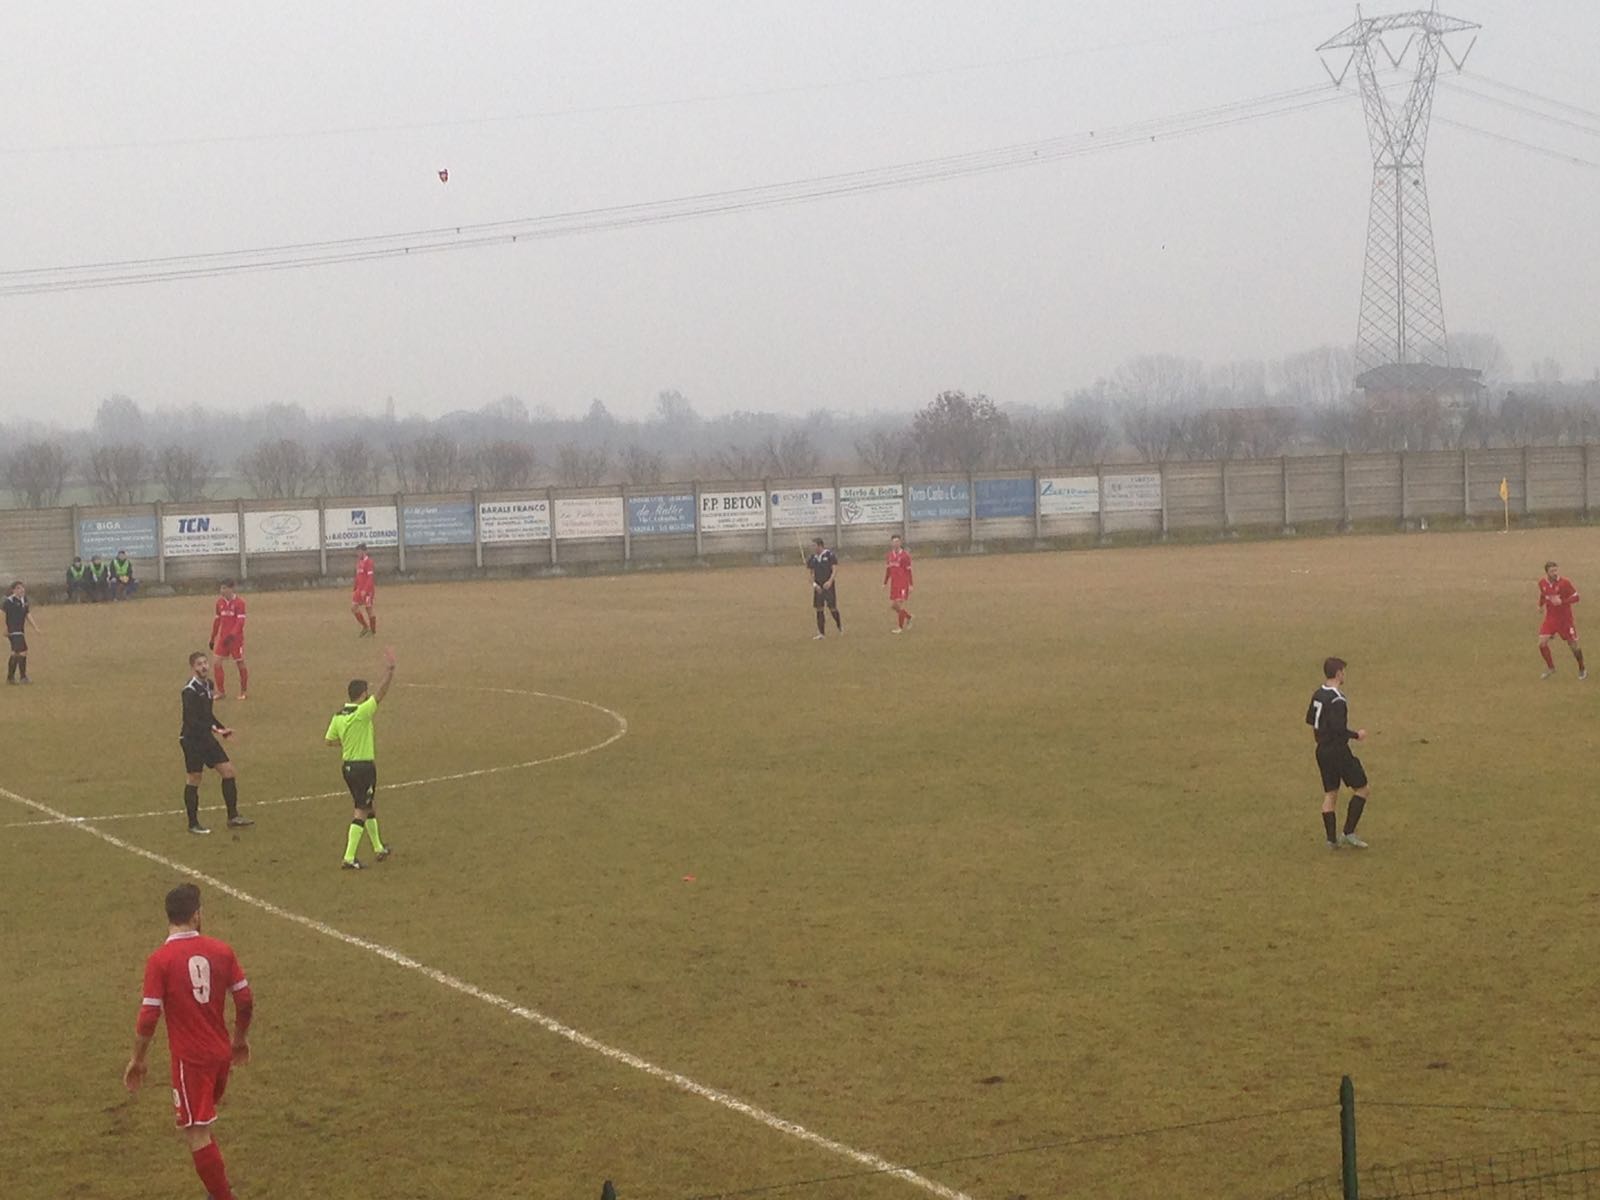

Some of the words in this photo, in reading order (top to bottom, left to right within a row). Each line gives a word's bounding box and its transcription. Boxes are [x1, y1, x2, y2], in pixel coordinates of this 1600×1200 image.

[481, 505, 511, 515] BARALE
[512, 503, 546, 513] FRANCO
[724, 495, 763, 510] BETON
[178, 517, 210, 533] TCN
[1313, 700, 1323, 729] 7
[188, 955, 210, 1004] 9
